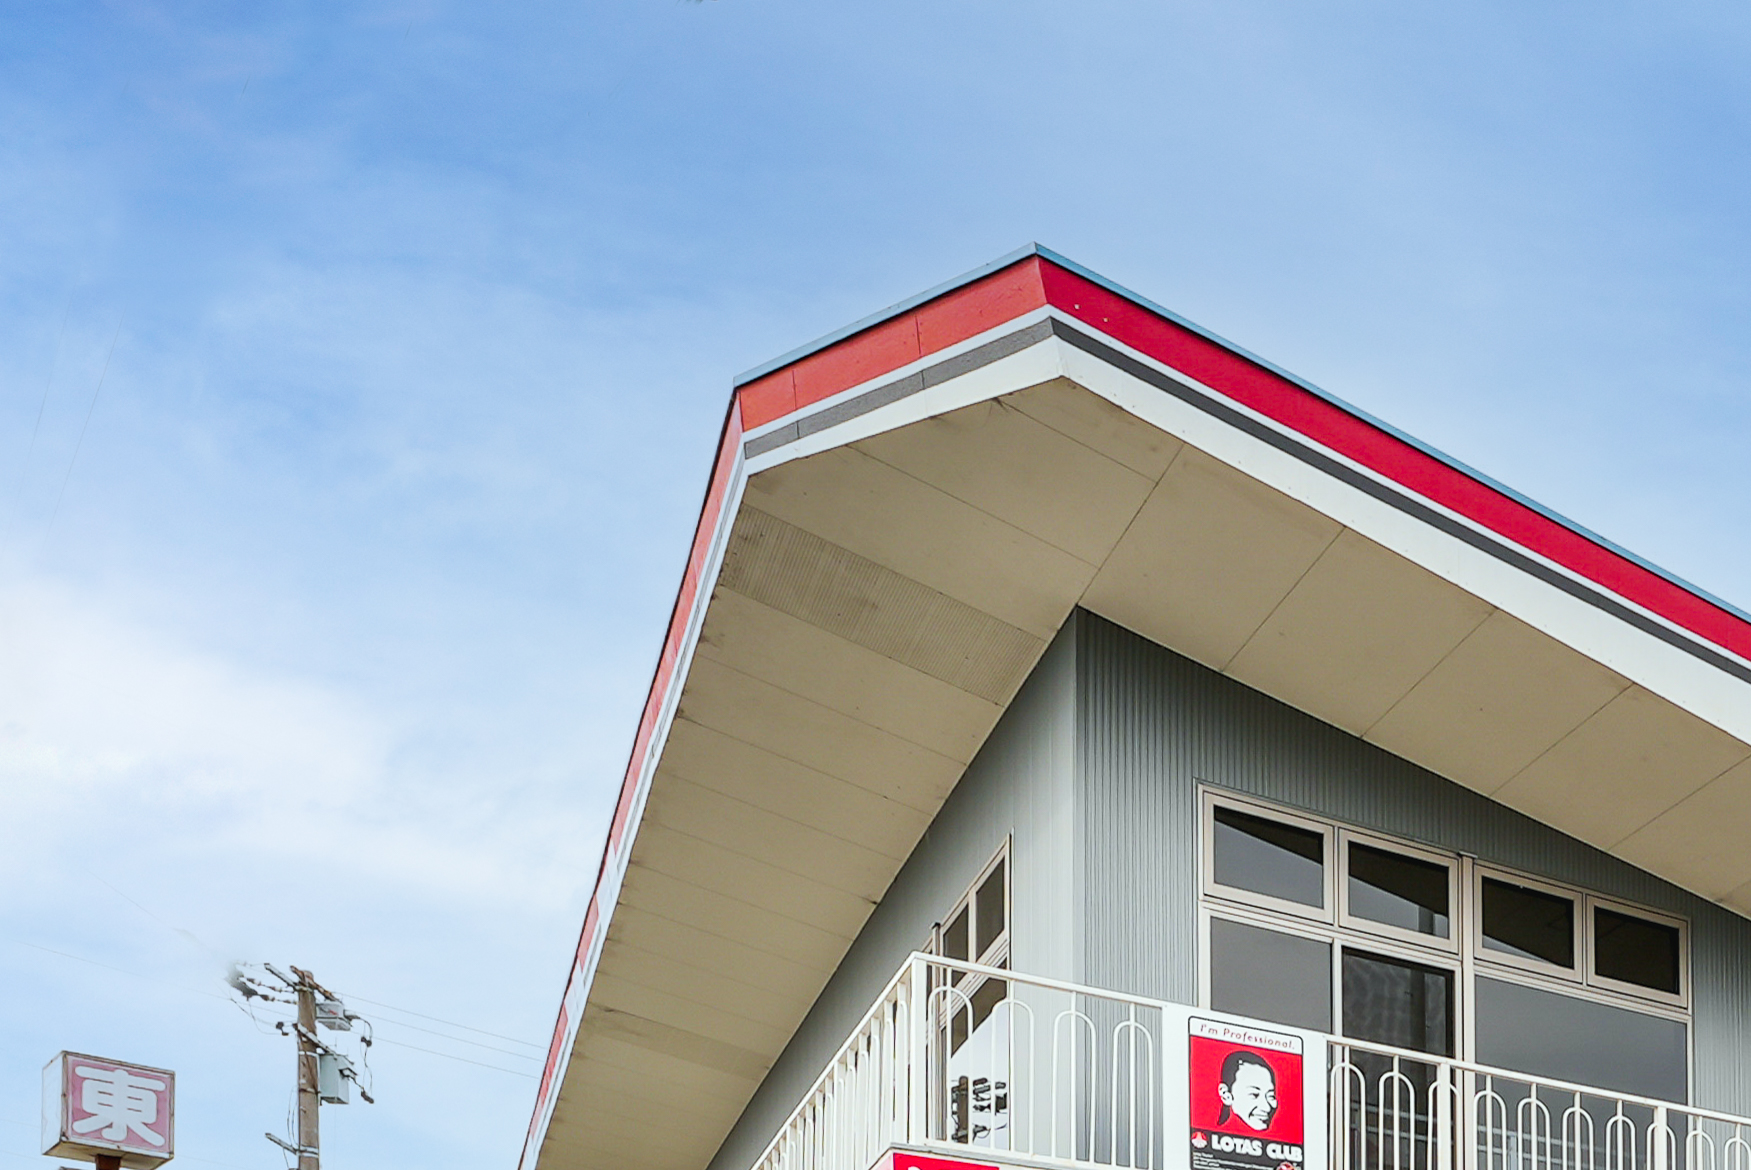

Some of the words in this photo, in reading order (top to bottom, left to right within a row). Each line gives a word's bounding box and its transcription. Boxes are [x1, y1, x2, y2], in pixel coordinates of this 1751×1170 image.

[1200, 1024, 1219, 1035] I'm
[1211, 1134, 1263, 1157] LOTAS
[1266, 1143, 1303, 1163] CLUB
